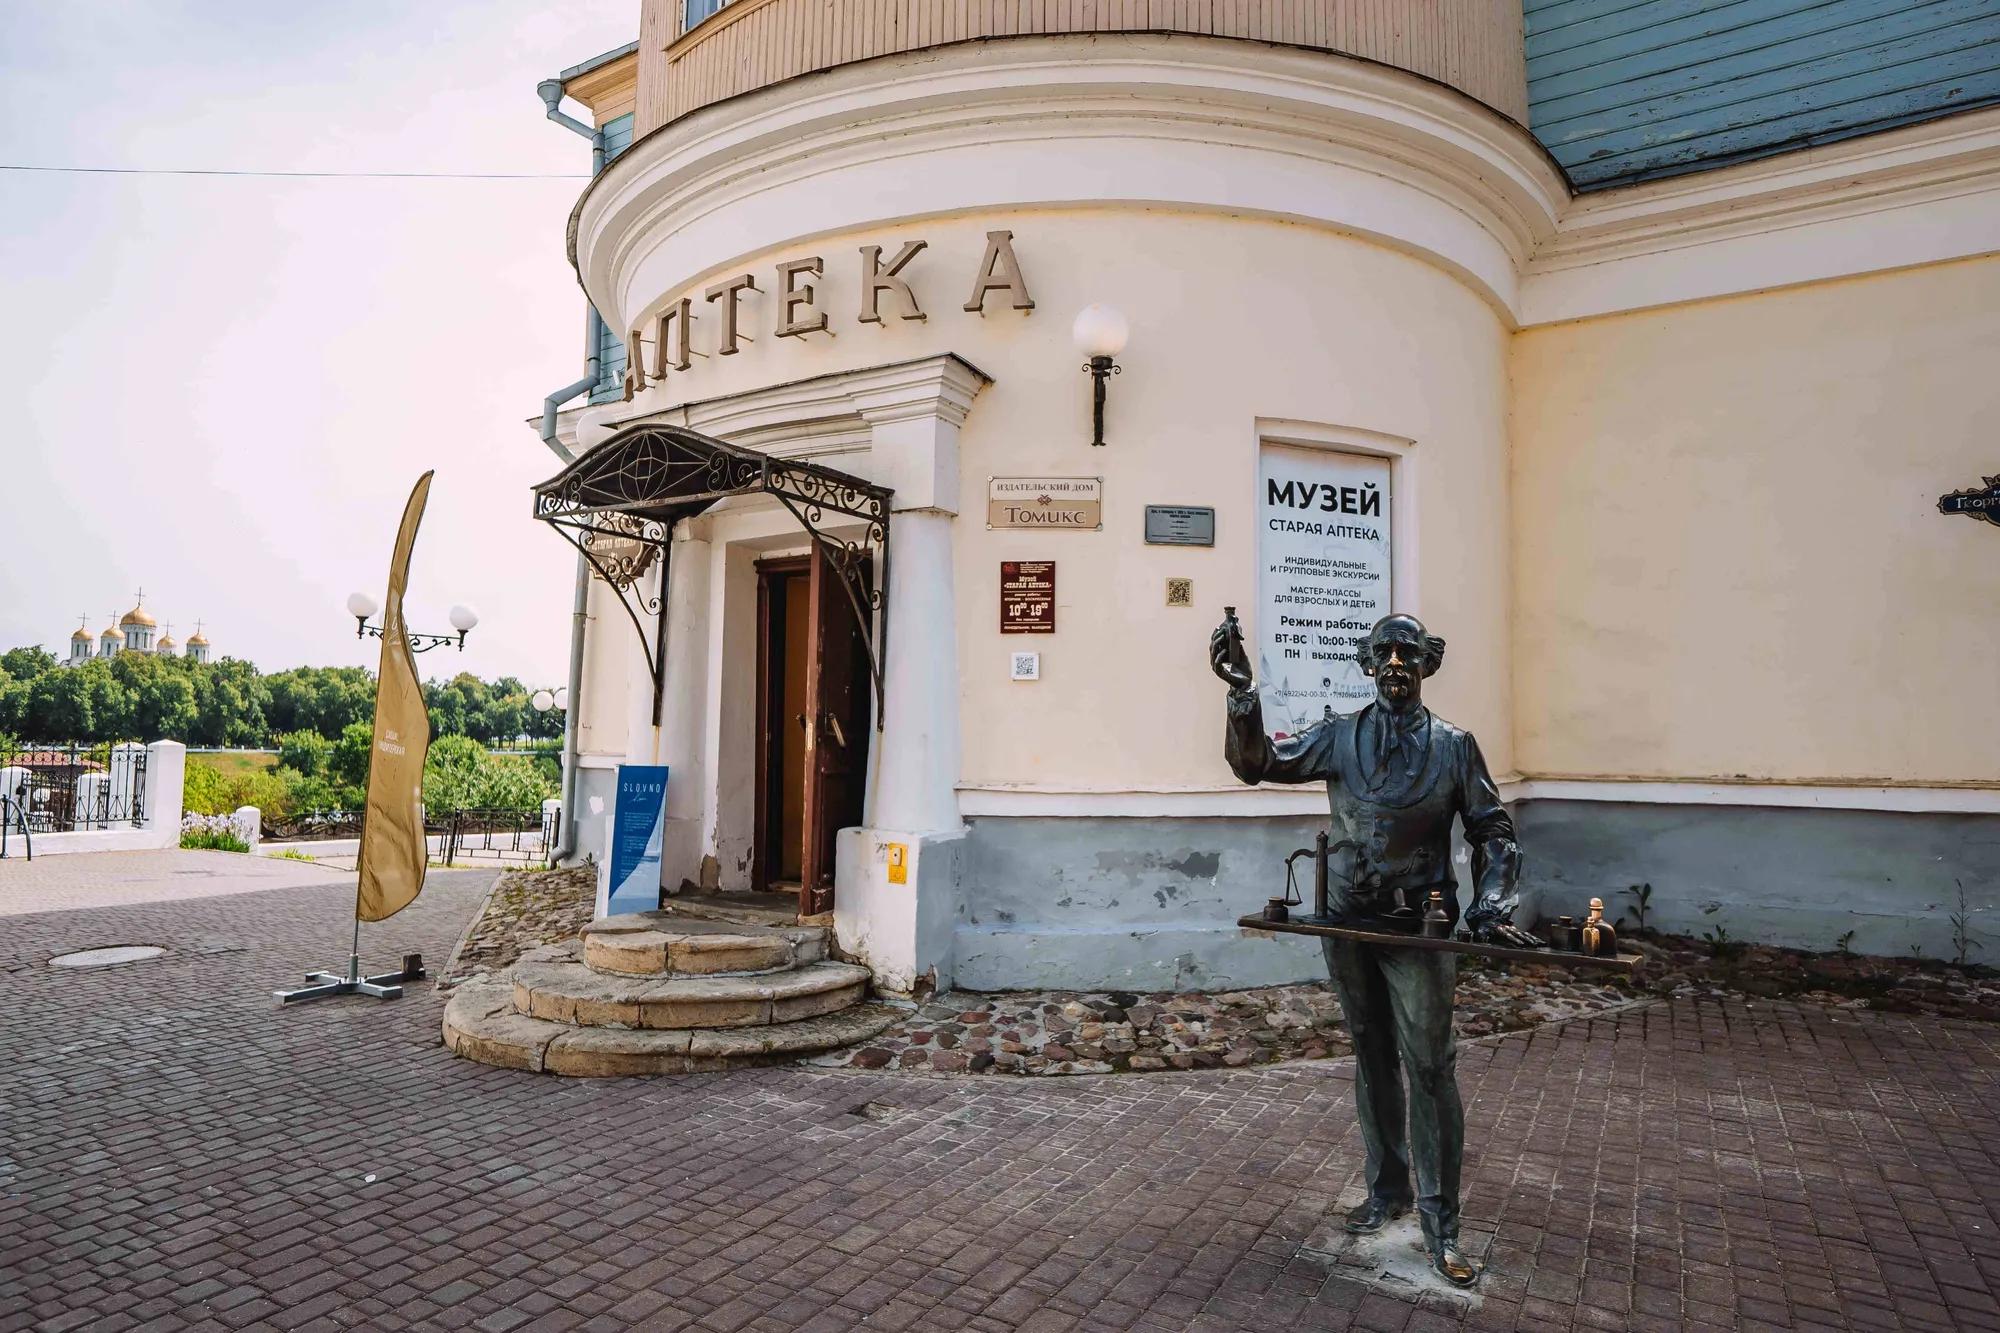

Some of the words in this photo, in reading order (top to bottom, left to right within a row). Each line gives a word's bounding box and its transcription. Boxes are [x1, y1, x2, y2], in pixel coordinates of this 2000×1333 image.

[622, 230, 1036, 402] АПТЕКА
[997, 482, 1070, 491] ИЗДАТЕЛЬСКИЙ
[1072, 483, 1094, 491] ДОМ
[1268, 478, 1380, 517] МУЗЕЙ
[1269, 519, 1322, 535] СТАРАЯ
[1327, 525, 1379, 541] АПТЕКА
[1285, 556, 1366, 570] ИНДИВИДУАЛЬНЫЕ
[1270, 565, 1277, 573] И
[1279, 567, 1330, 577] ГРУППОВЫЕ
[1332, 571, 1380, 581] ЭКСКУРСИИ
[1290, 586, 1361, 598] МАСТЕР-КЛАССЫ
[1274, 595, 1292, 604] ДЛЯ
[1294, 596, 1340, 606] ВЗРОСЛЫХ
[1350, 599, 1376, 609] ДЕТЕЙ
[1280, 616, 1322, 628] Режим
[1325, 618, 1372, 631] работы:
[1275, 634, 1307, 645] ВТ-ВС
[1318, 636, 1358, 647] 10:00-19
[1285, 649, 1300, 659] ПН
[1312, 651, 1359, 662] выходно
[623, 783, 661, 793] SLOVNO
